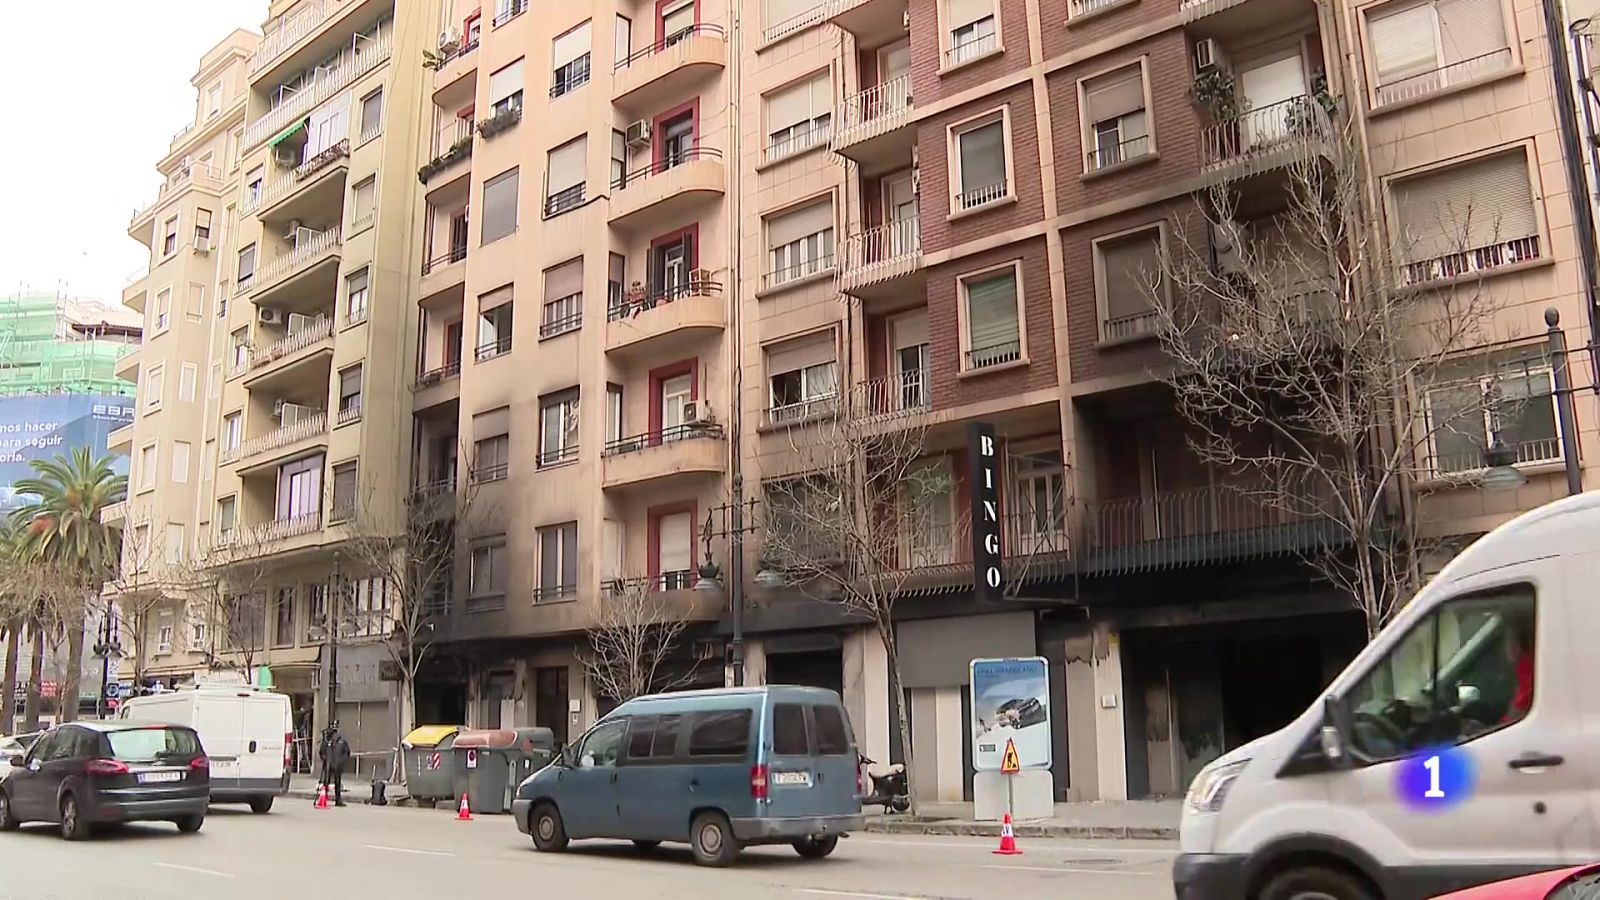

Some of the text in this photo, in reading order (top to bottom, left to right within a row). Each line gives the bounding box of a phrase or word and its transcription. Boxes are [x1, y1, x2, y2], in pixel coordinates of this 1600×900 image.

[25, 420, 58, 432] hacer
[25, 434, 63, 449] seguir
[980, 435, 1001, 588] BINGO
